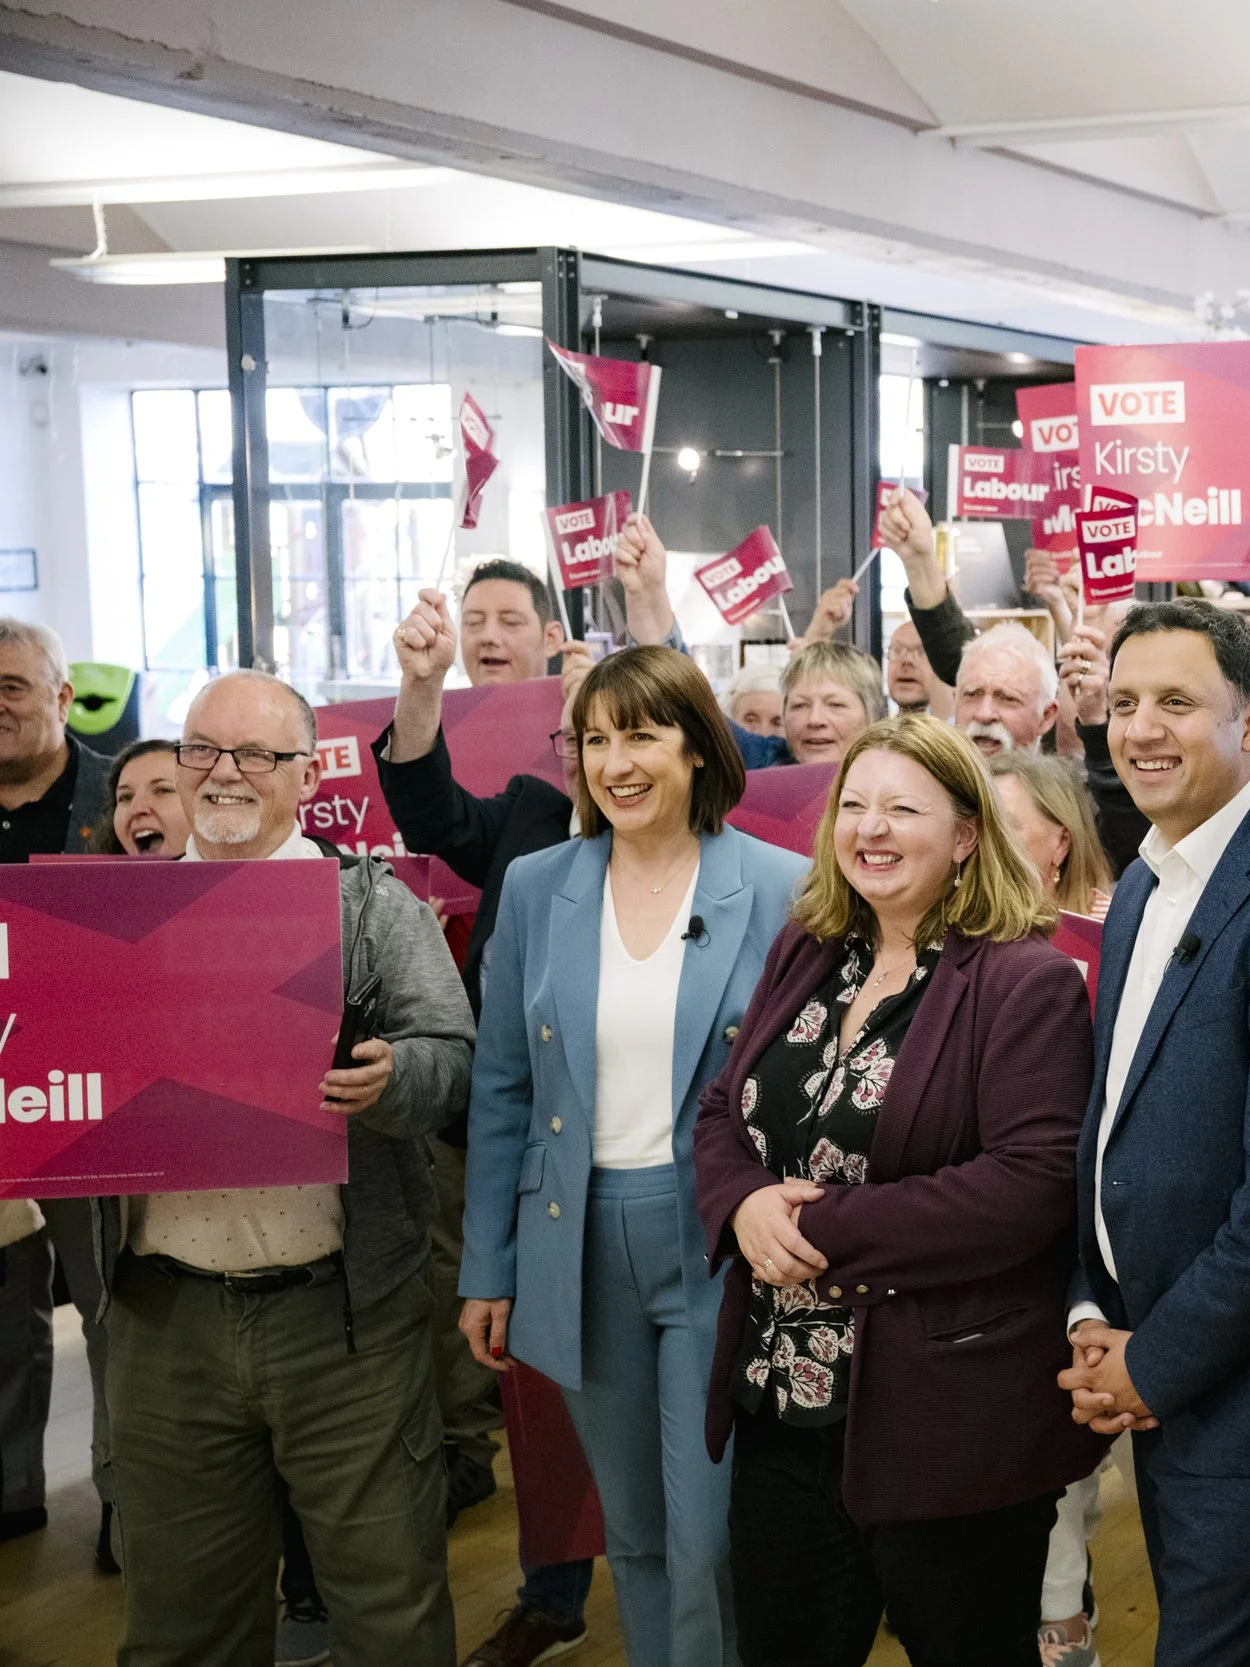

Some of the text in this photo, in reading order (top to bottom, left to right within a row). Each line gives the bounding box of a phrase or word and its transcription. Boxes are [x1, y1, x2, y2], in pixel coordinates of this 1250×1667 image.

[1098, 390, 1177, 417] VOTE
[1038, 422, 1077, 446] VO
[968, 458, 999, 468] VOTE
[1094, 439, 1190, 484] Kirsty
[963, 476, 1050, 502] Labour
[1137, 486, 1242, 526] cNeill
[560, 513, 591, 529] VOTE
[1087, 521, 1131, 538] VOTE
[1085, 546, 1136, 579] Lab
[318, 745, 352, 771] TE
[299, 794, 369, 835] rsty
[0, 1069, 103, 1124] eill
